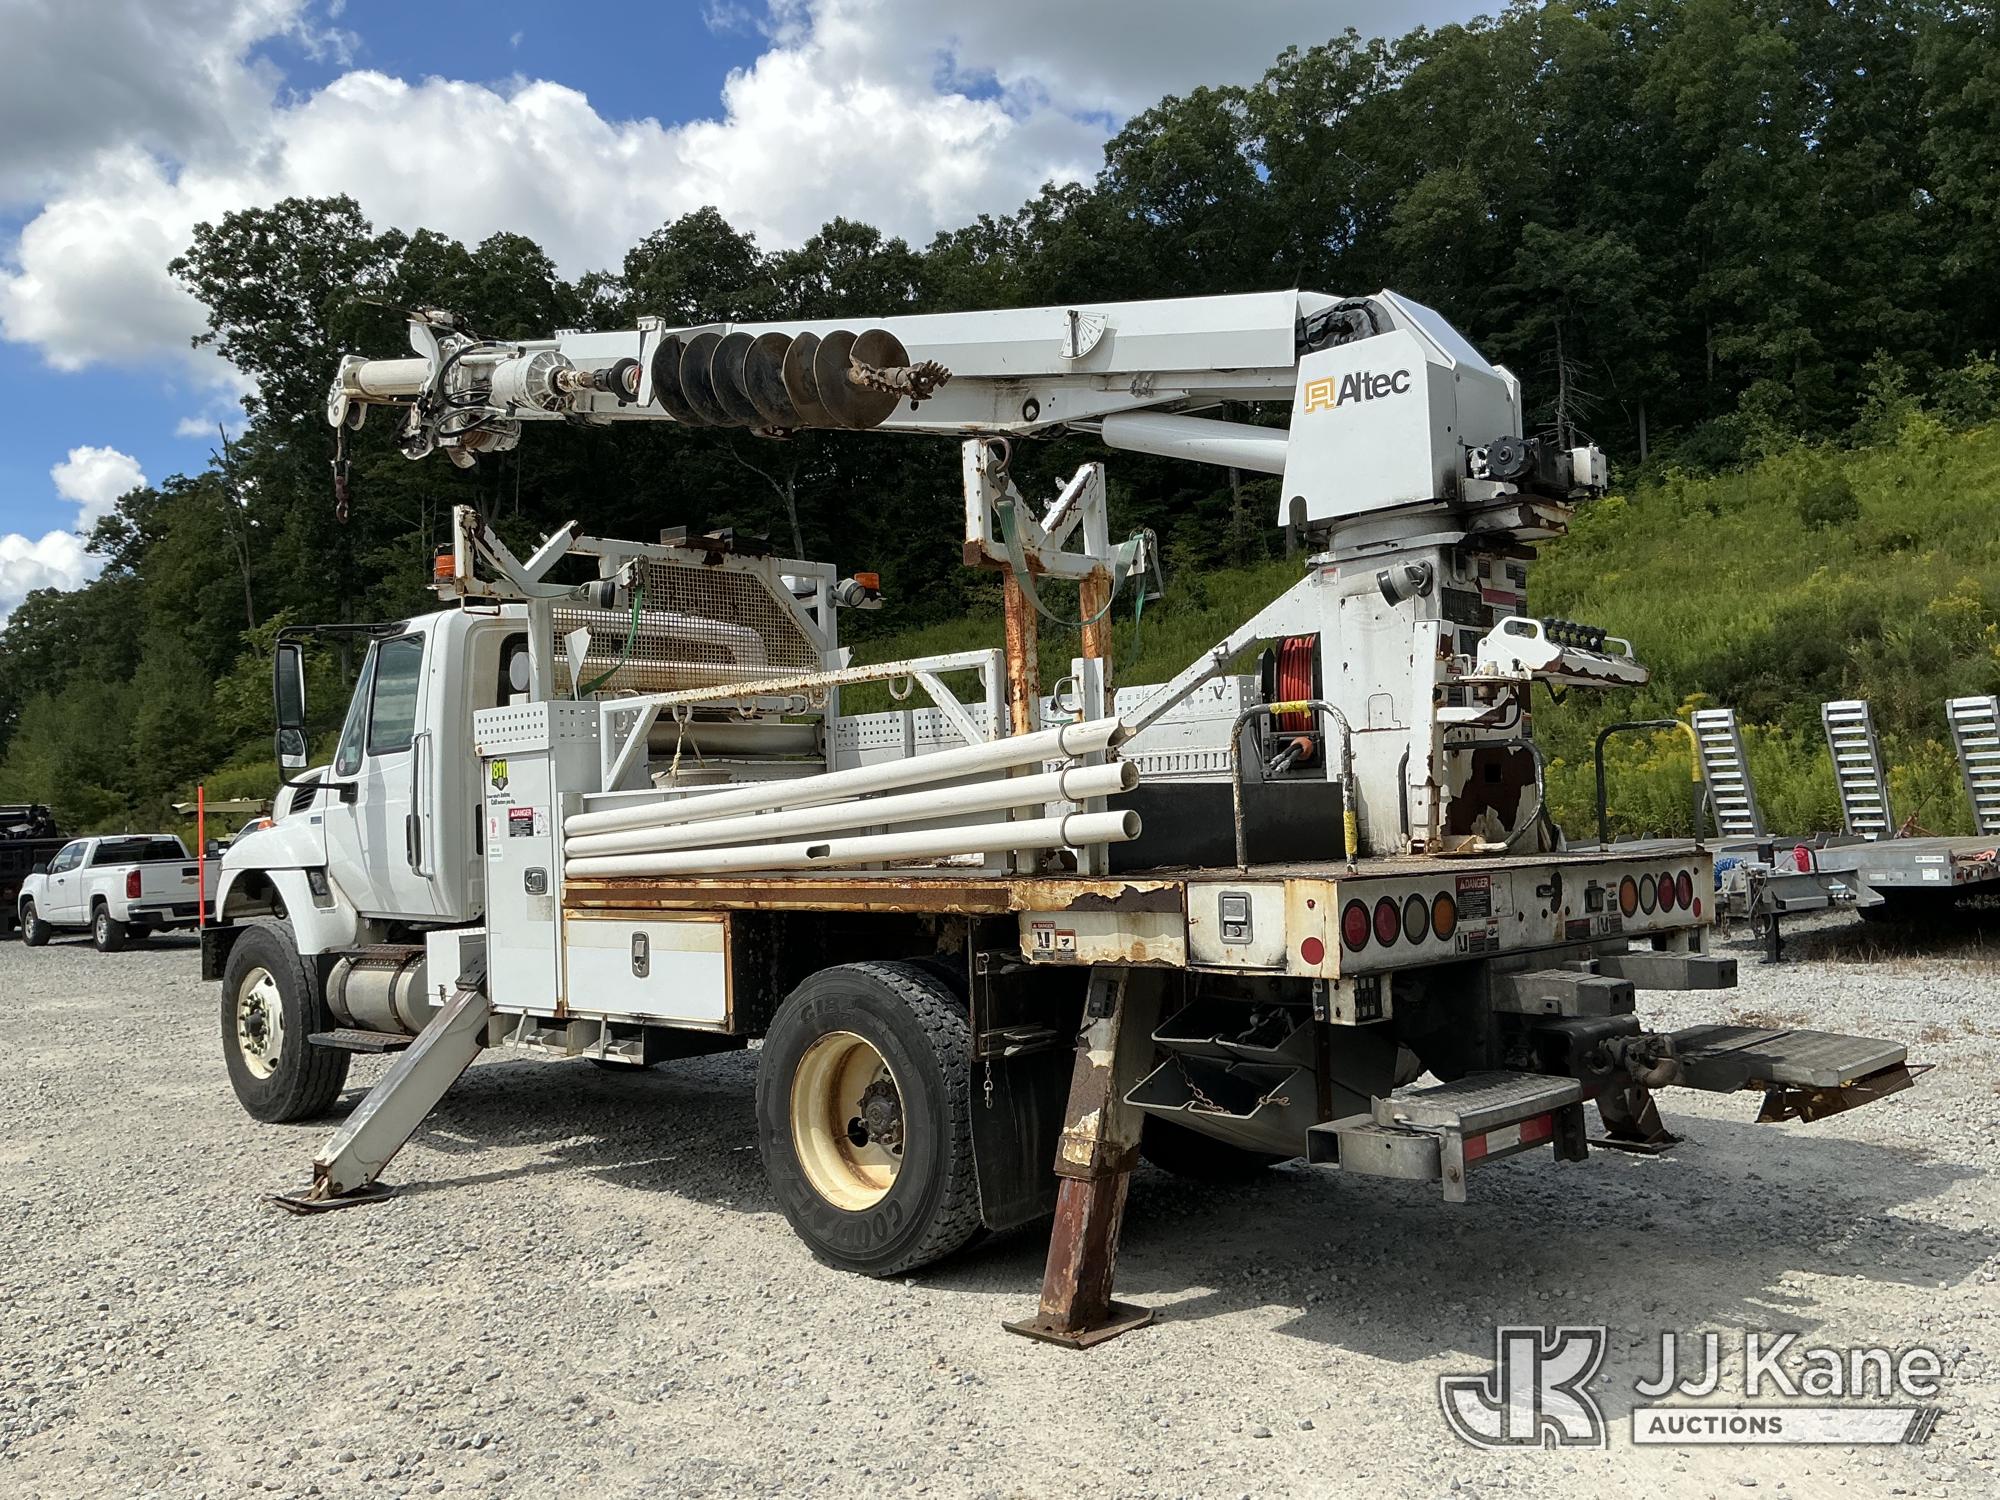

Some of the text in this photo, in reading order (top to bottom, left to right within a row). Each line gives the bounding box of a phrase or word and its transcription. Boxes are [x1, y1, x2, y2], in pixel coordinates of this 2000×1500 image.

[1336, 369, 1411, 407] Altec
[492, 760, 508, 779] 811
[514, 808, 532, 817] DANGER
[1465, 877, 1489, 889] DANGER
